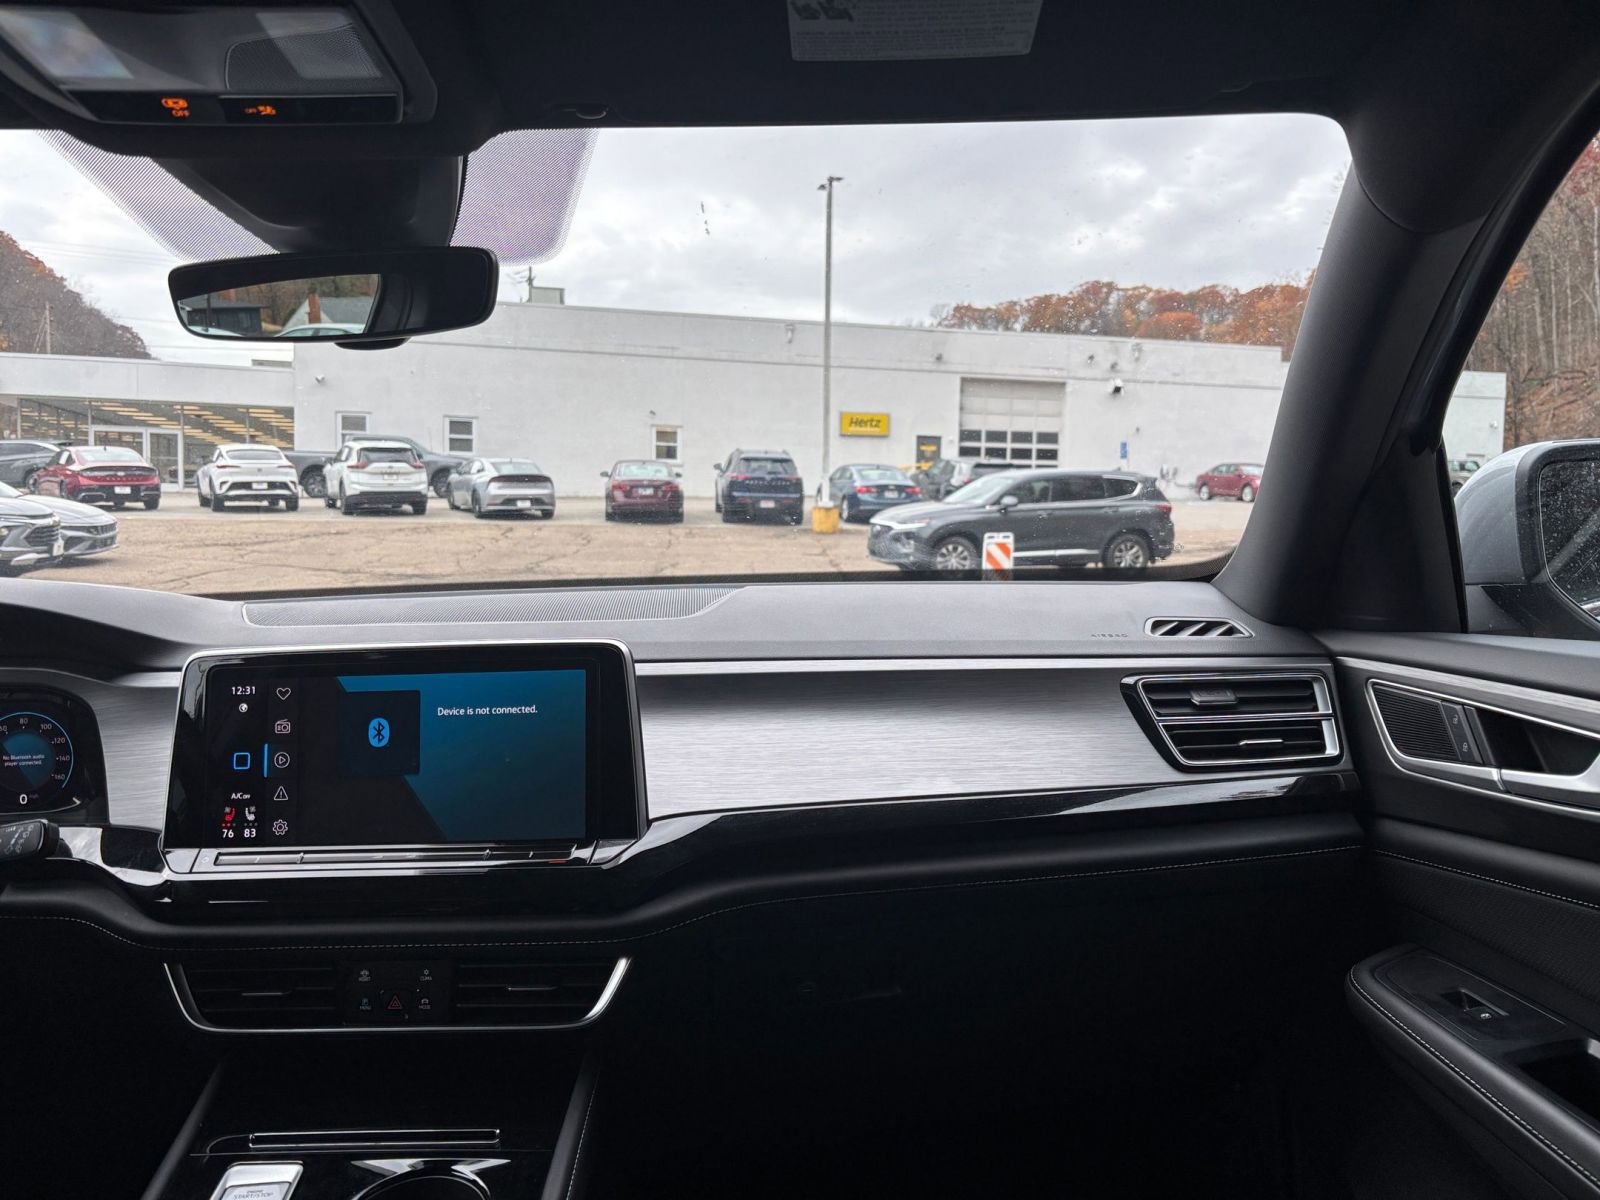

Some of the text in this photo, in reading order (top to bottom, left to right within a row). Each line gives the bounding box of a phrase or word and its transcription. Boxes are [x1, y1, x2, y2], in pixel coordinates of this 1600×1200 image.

[849, 416, 882, 428] Hertz
[231, 686, 256, 695] 12:31
[437, 704, 538, 716] Device is not connected.
[19, 794, 28, 805] 0
[230, 792, 243, 800] A/C
[221, 828, 257, 838] 76 83
